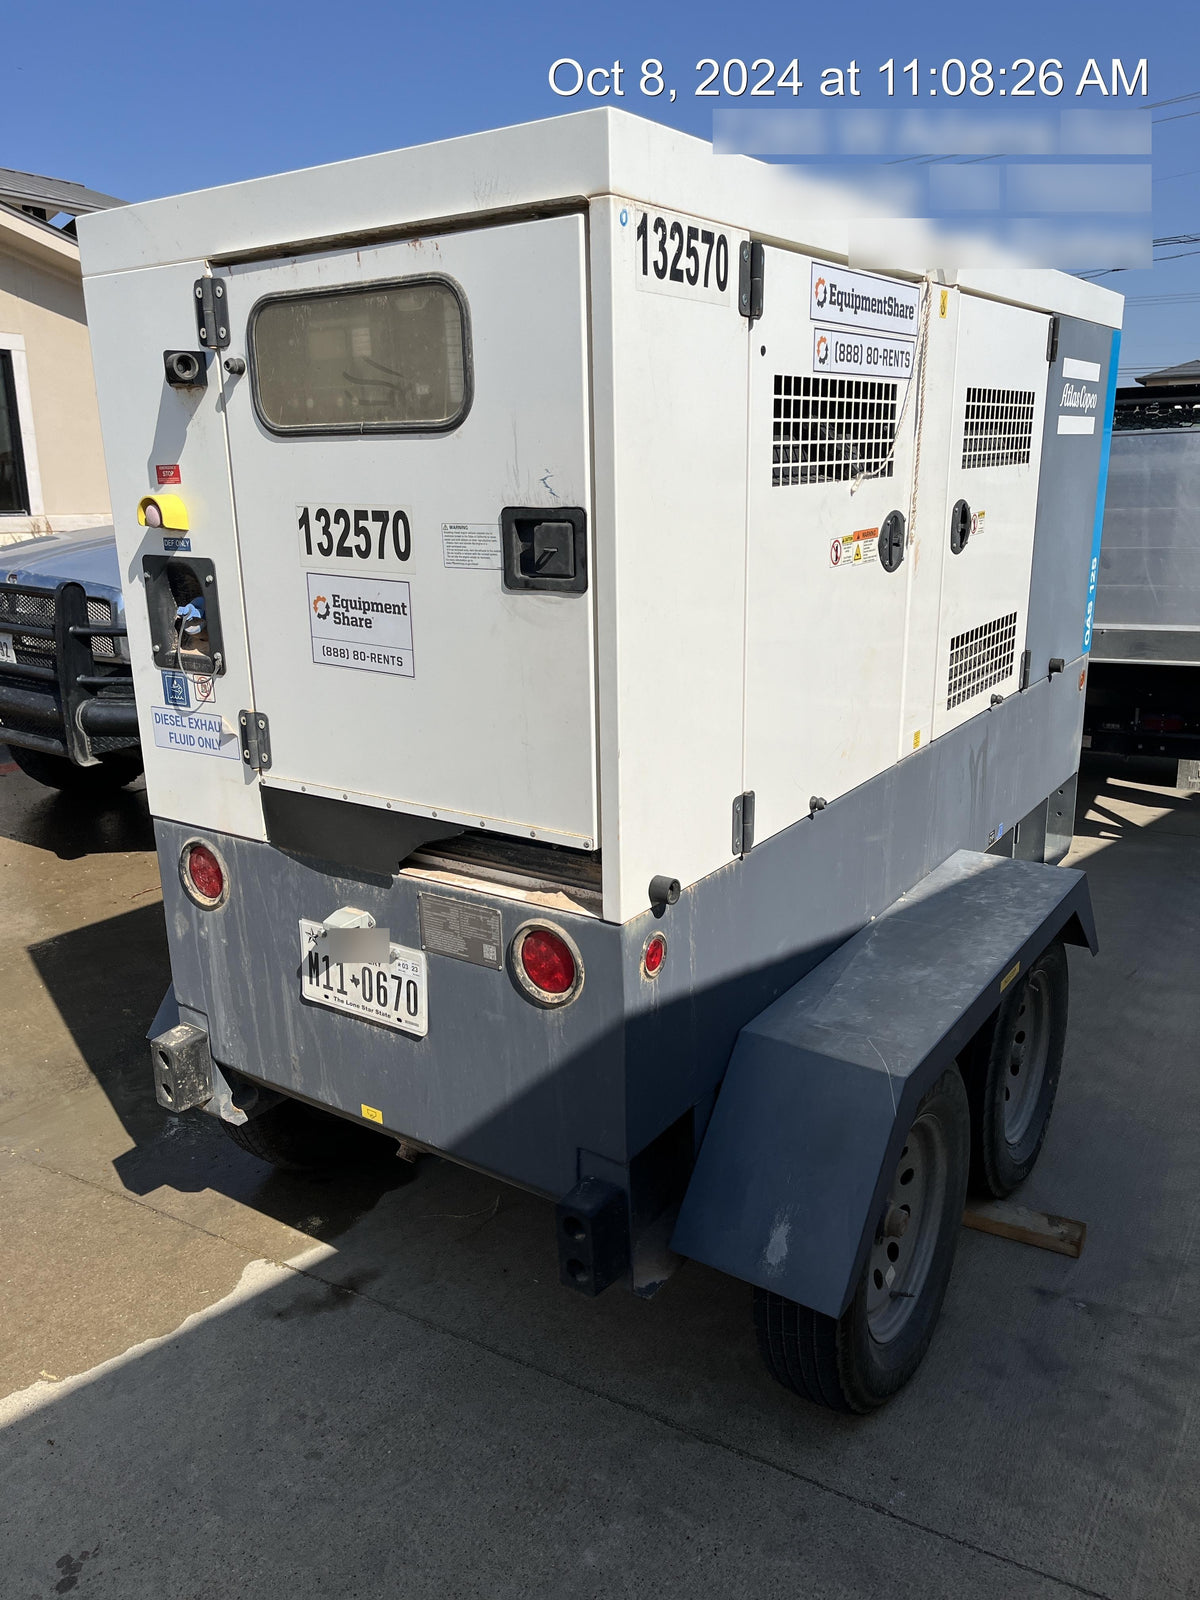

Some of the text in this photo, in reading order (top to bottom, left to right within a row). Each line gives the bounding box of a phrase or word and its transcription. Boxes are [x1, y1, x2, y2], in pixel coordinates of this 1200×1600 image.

[636, 212, 729, 292] 132570
[828, 282, 915, 321] EquipmentShare
[834, 341, 911, 369] (888) 80-RENTS
[164, 539, 175, 547] DEF
[175, 540, 190, 548] ONLY
[298, 507, 411, 561] 132570
[331, 594, 408, 616] Equipment
[333, 611, 373, 629] Share
[322, 645, 403, 667] (888) 80-RENTS
[154, 712, 187, 728] DIESEL
[169, 731, 221, 751] FLUID ONLY
[361, 966, 418, 1017] 0670
[333, 996, 391, 1019] The Lone Star State
